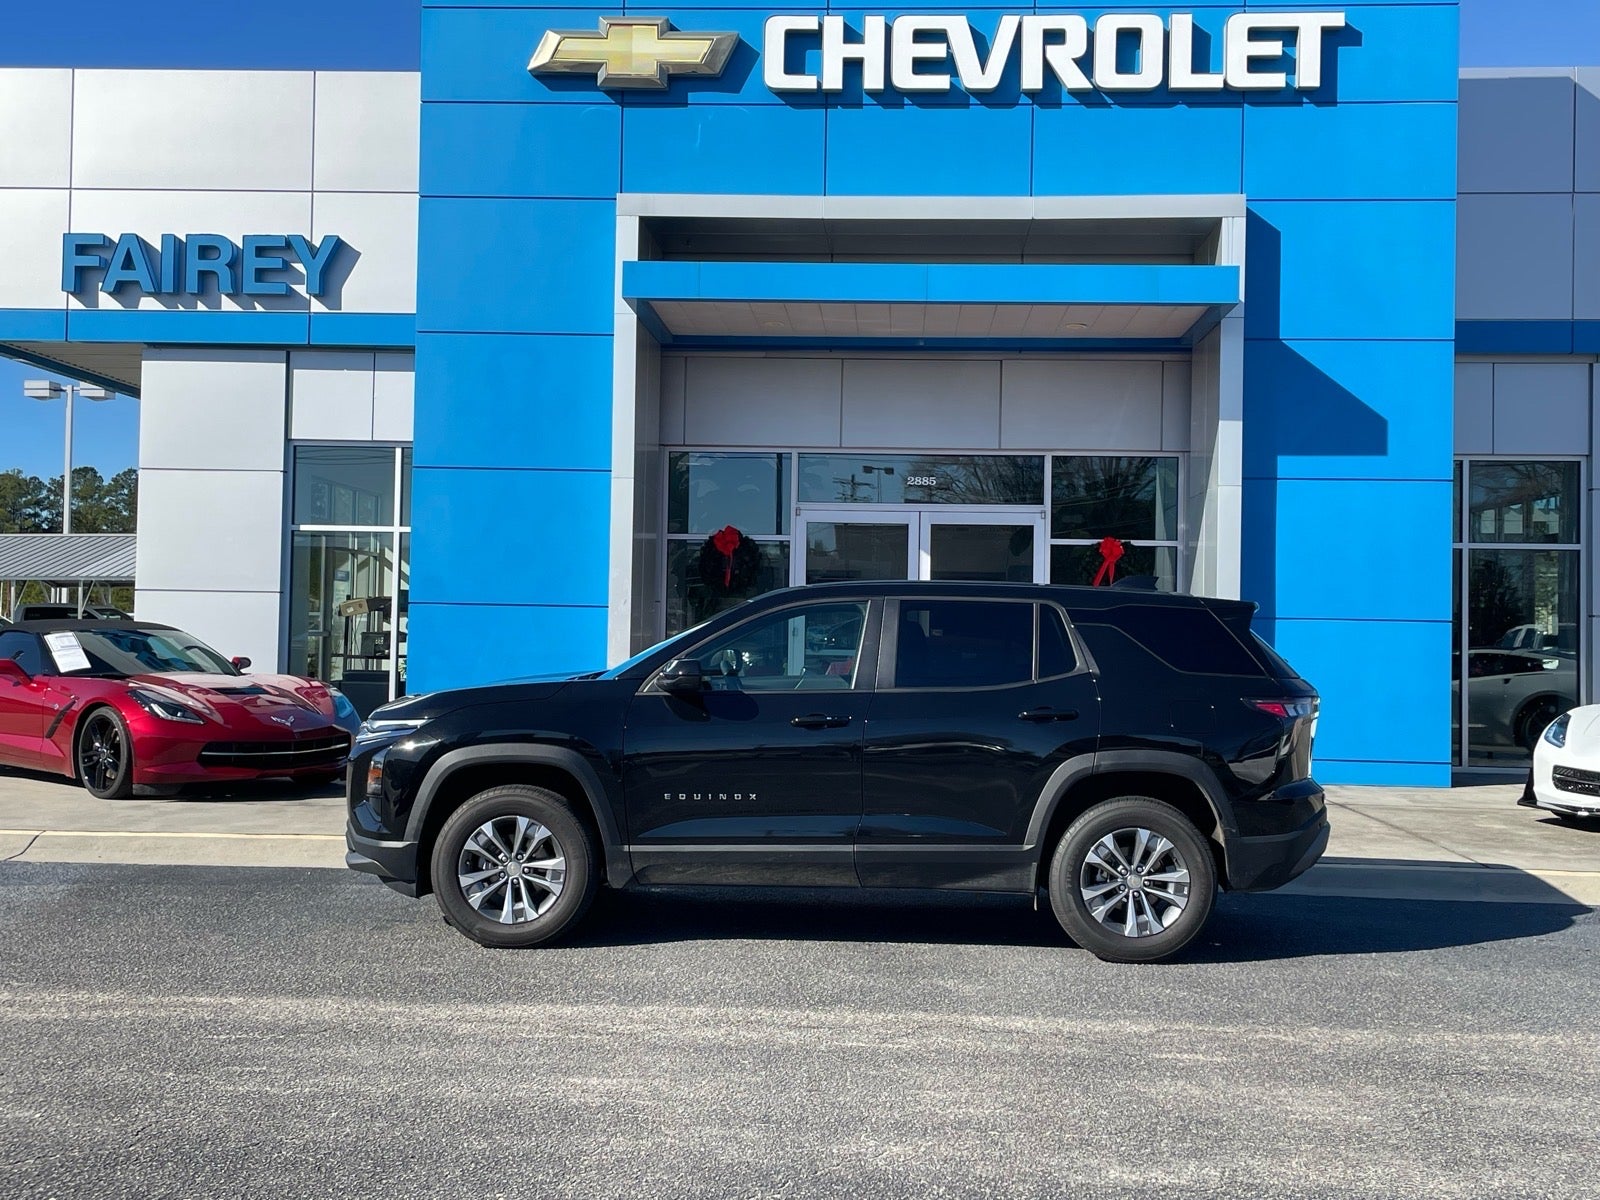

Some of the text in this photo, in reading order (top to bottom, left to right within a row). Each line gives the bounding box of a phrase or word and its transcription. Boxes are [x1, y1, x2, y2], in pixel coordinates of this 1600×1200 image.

[763, 11, 1346, 94] CHEVROLET
[61, 232, 342, 297] FAIREY
[906, 476, 937, 486] 2885
